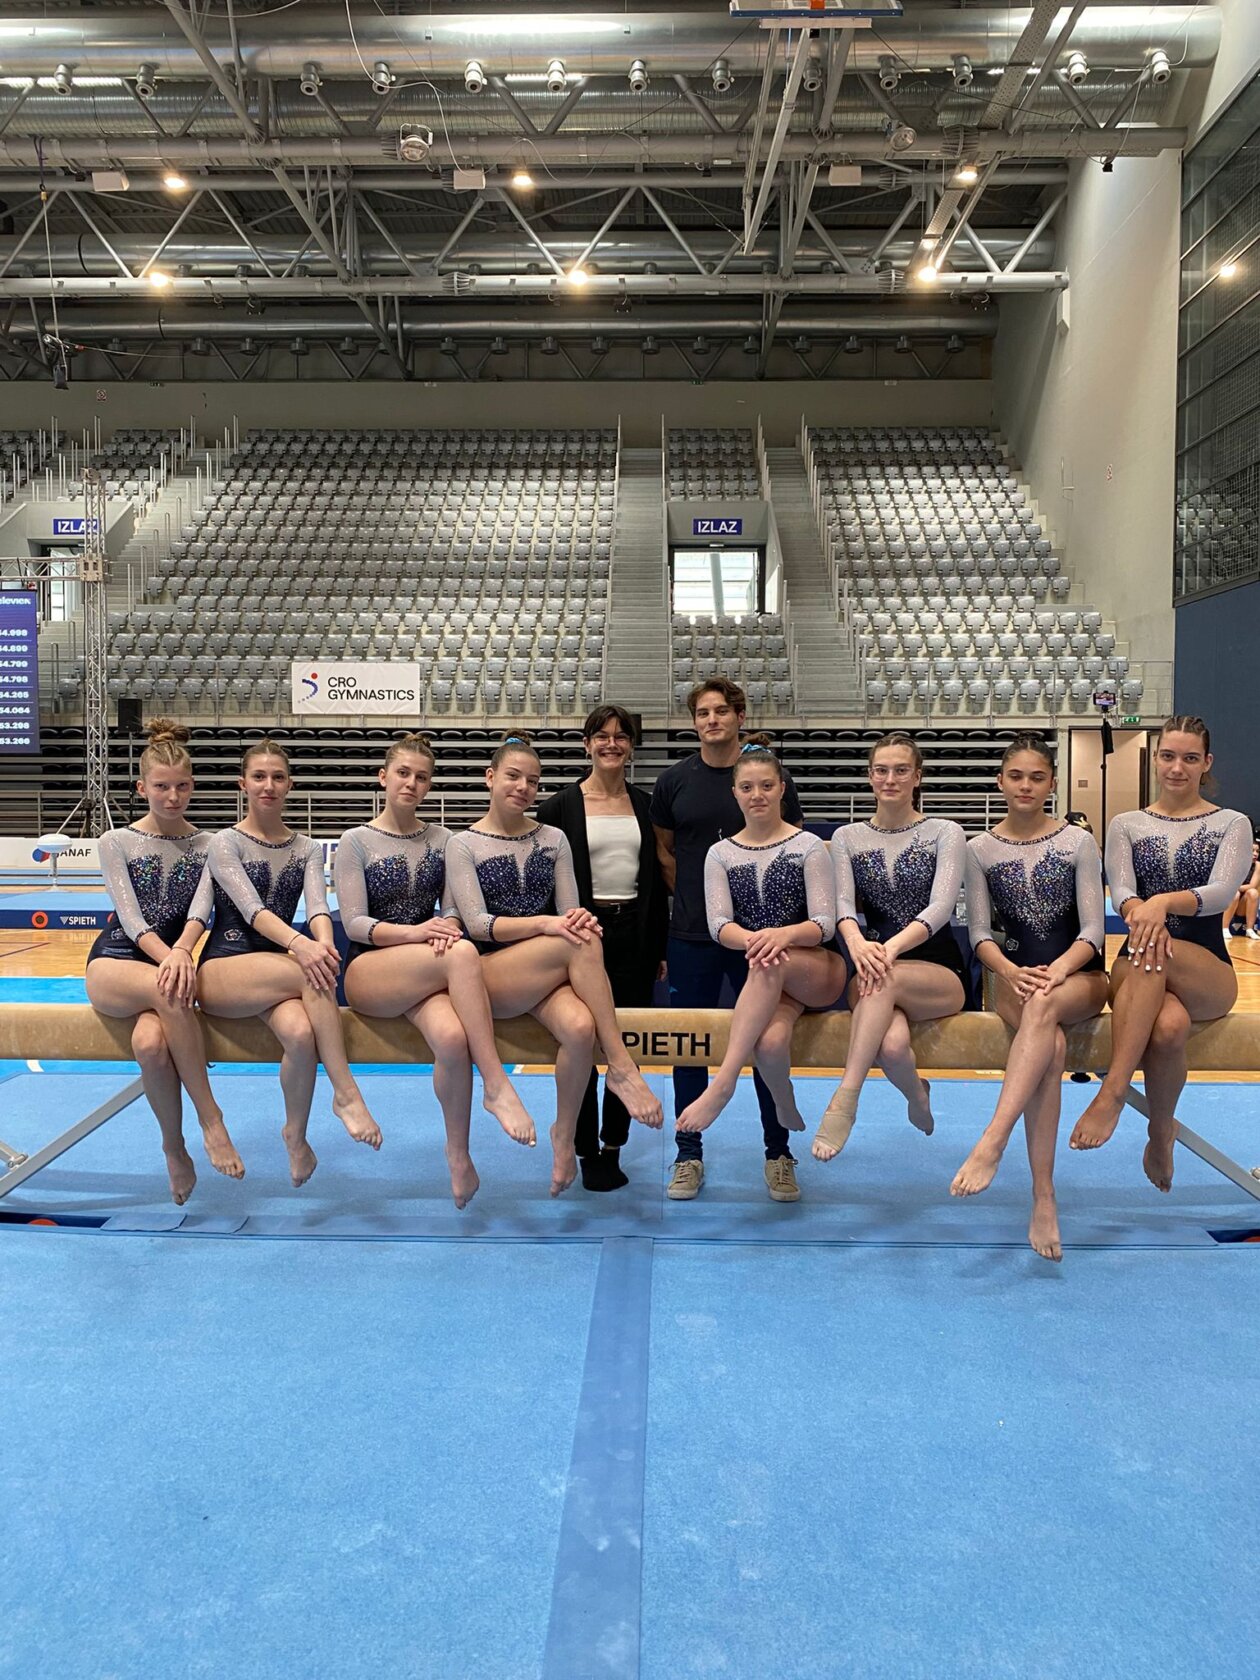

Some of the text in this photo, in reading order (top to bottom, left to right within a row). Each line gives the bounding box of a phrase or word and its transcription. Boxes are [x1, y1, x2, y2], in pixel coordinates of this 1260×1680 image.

[57, 521, 97, 533] IZLAZ
[698, 521, 738, 533] IZLAZ
[327, 676, 357, 688] CRO
[327, 689, 415, 700] GYMNASTICS
[57, 848, 91, 857] ANAF
[68, 916, 96, 925] SPIETH
[621, 1031, 711, 1057] PIETH
